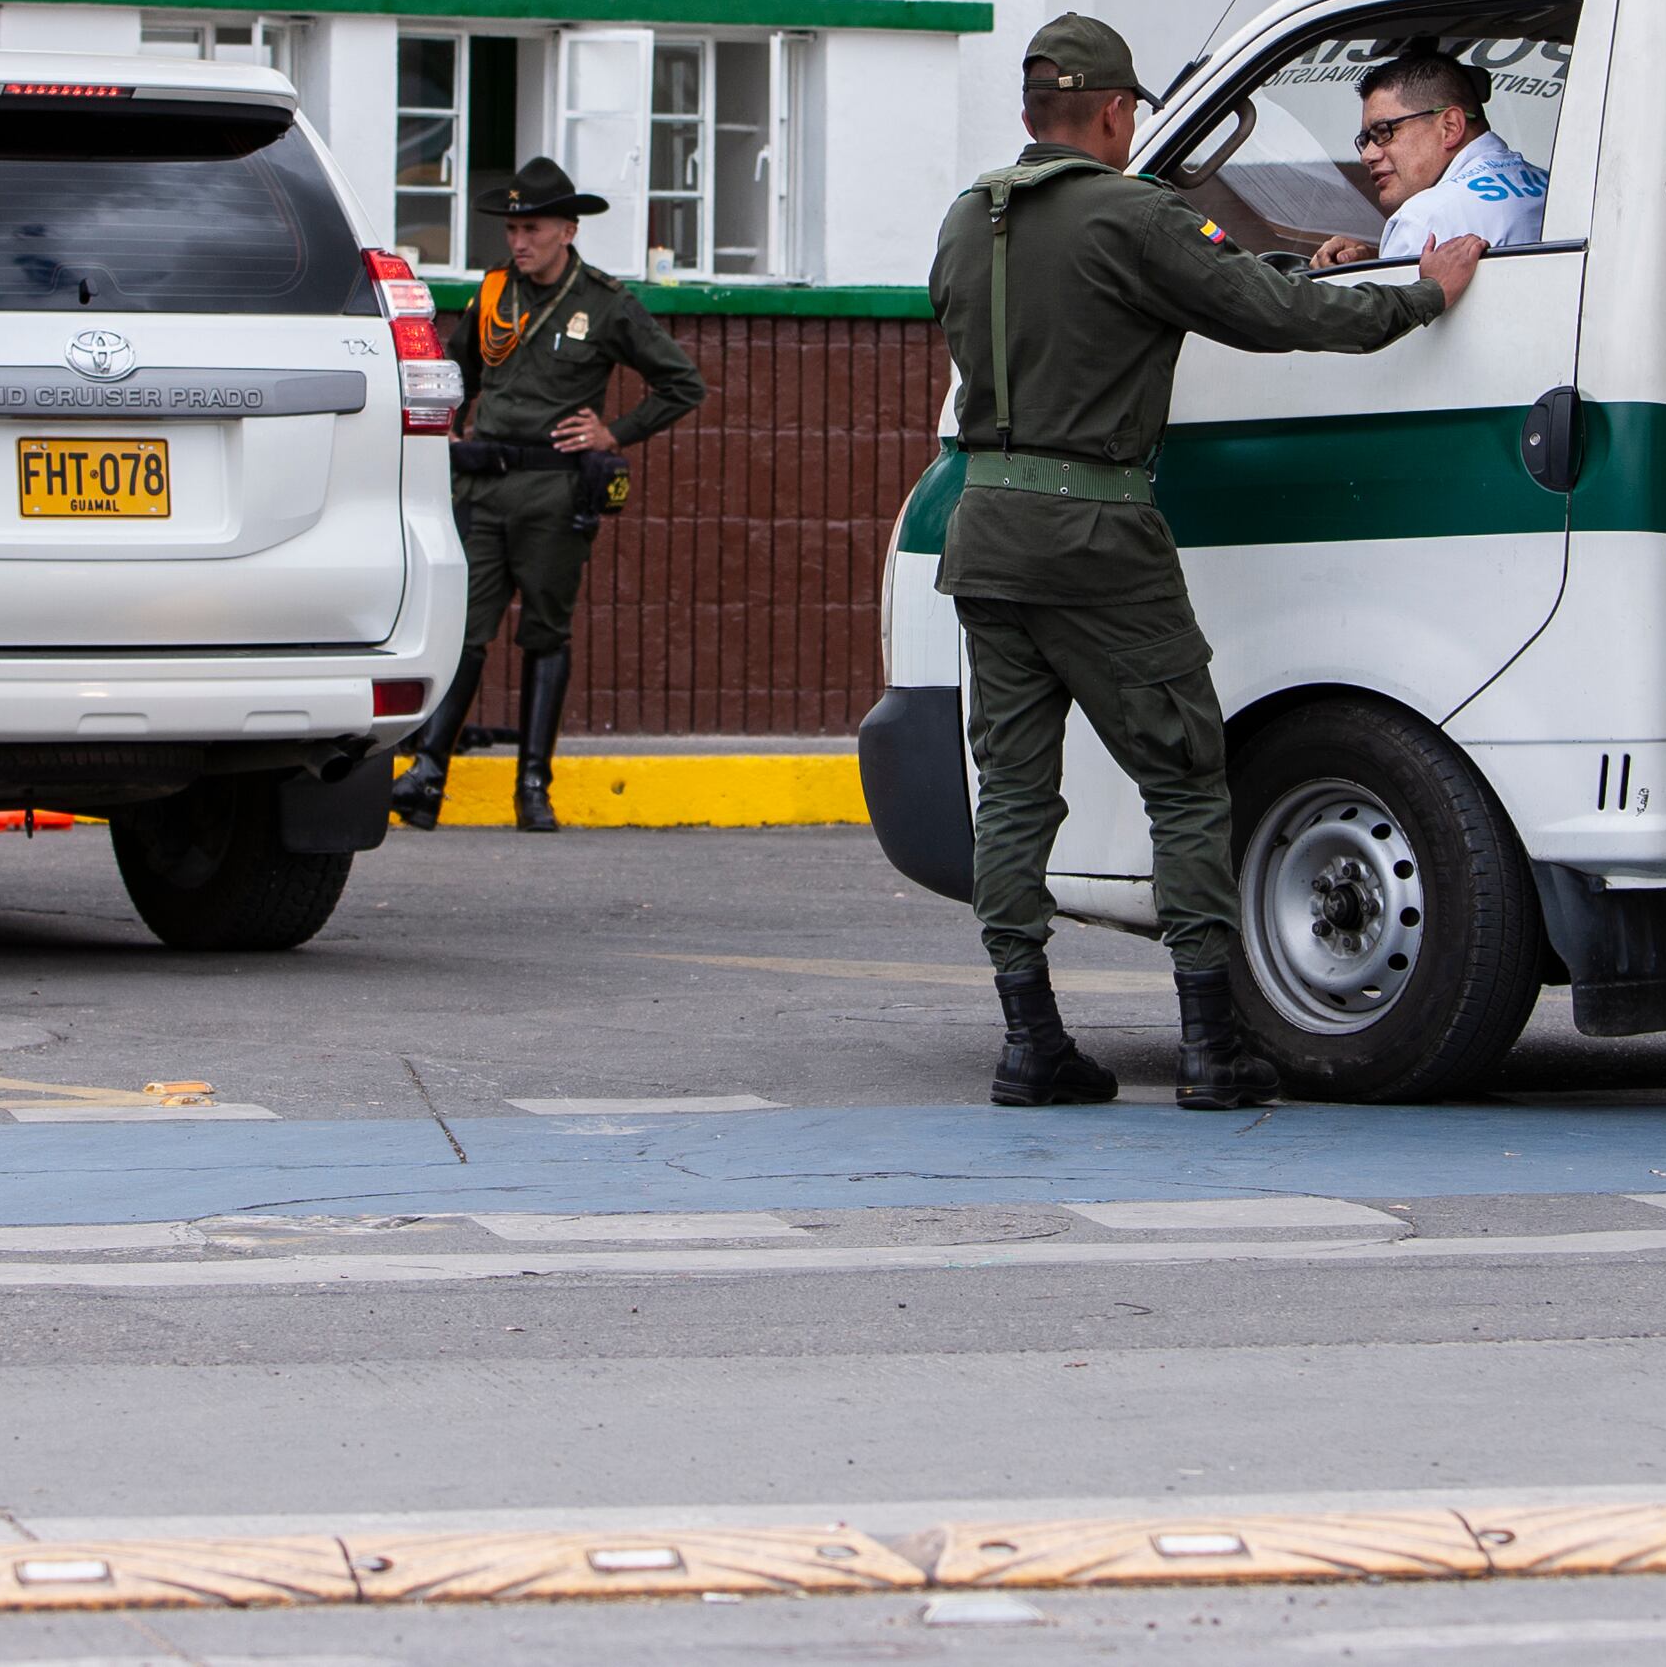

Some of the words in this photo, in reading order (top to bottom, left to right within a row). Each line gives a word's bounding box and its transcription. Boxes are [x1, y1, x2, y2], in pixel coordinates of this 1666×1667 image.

[342, 337, 380, 356] TX
[34, 385, 163, 408] CRUISER
[169, 386, 264, 409] PRADO
[70, 499, 120, 512] GUAMAL
